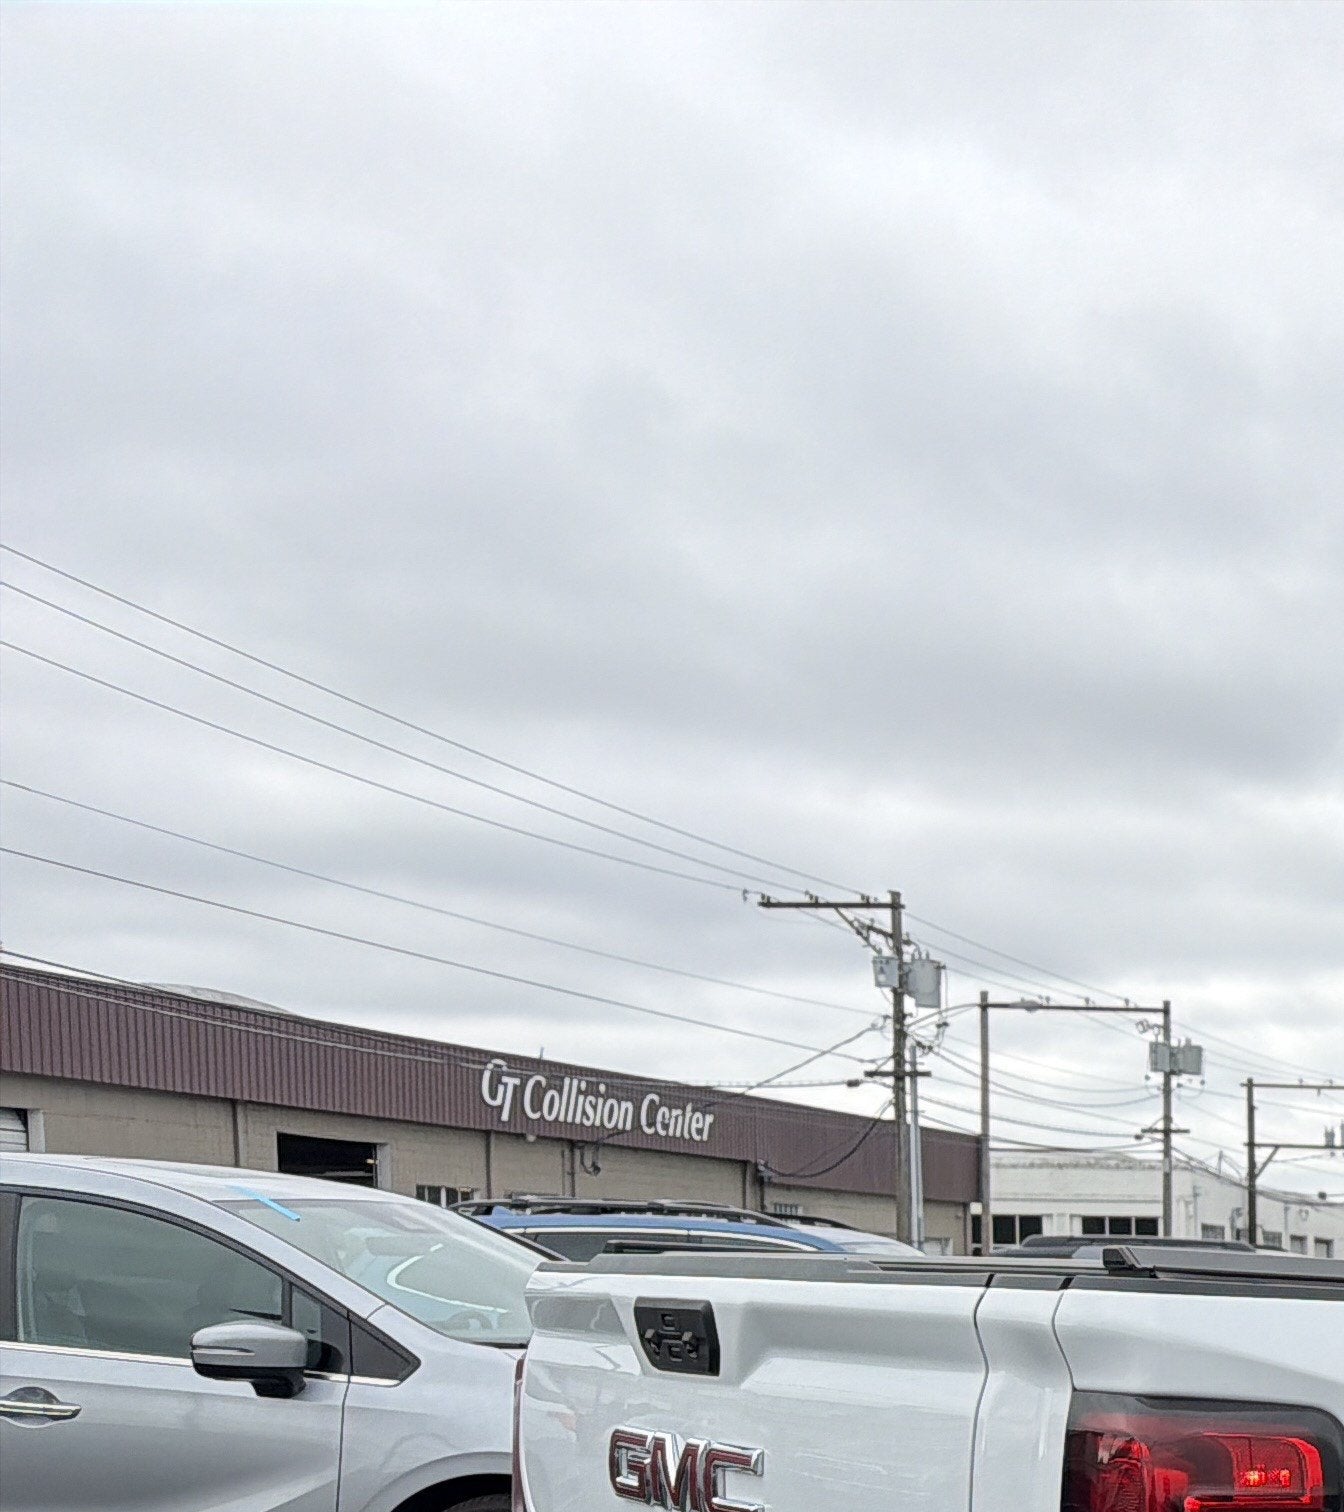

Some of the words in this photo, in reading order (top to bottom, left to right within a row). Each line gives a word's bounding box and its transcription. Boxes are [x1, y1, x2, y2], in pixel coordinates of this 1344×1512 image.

[481, 1058, 521, 1122] GT
[523, 1074, 635, 1132] Collision
[639, 1092, 715, 1143] Center
